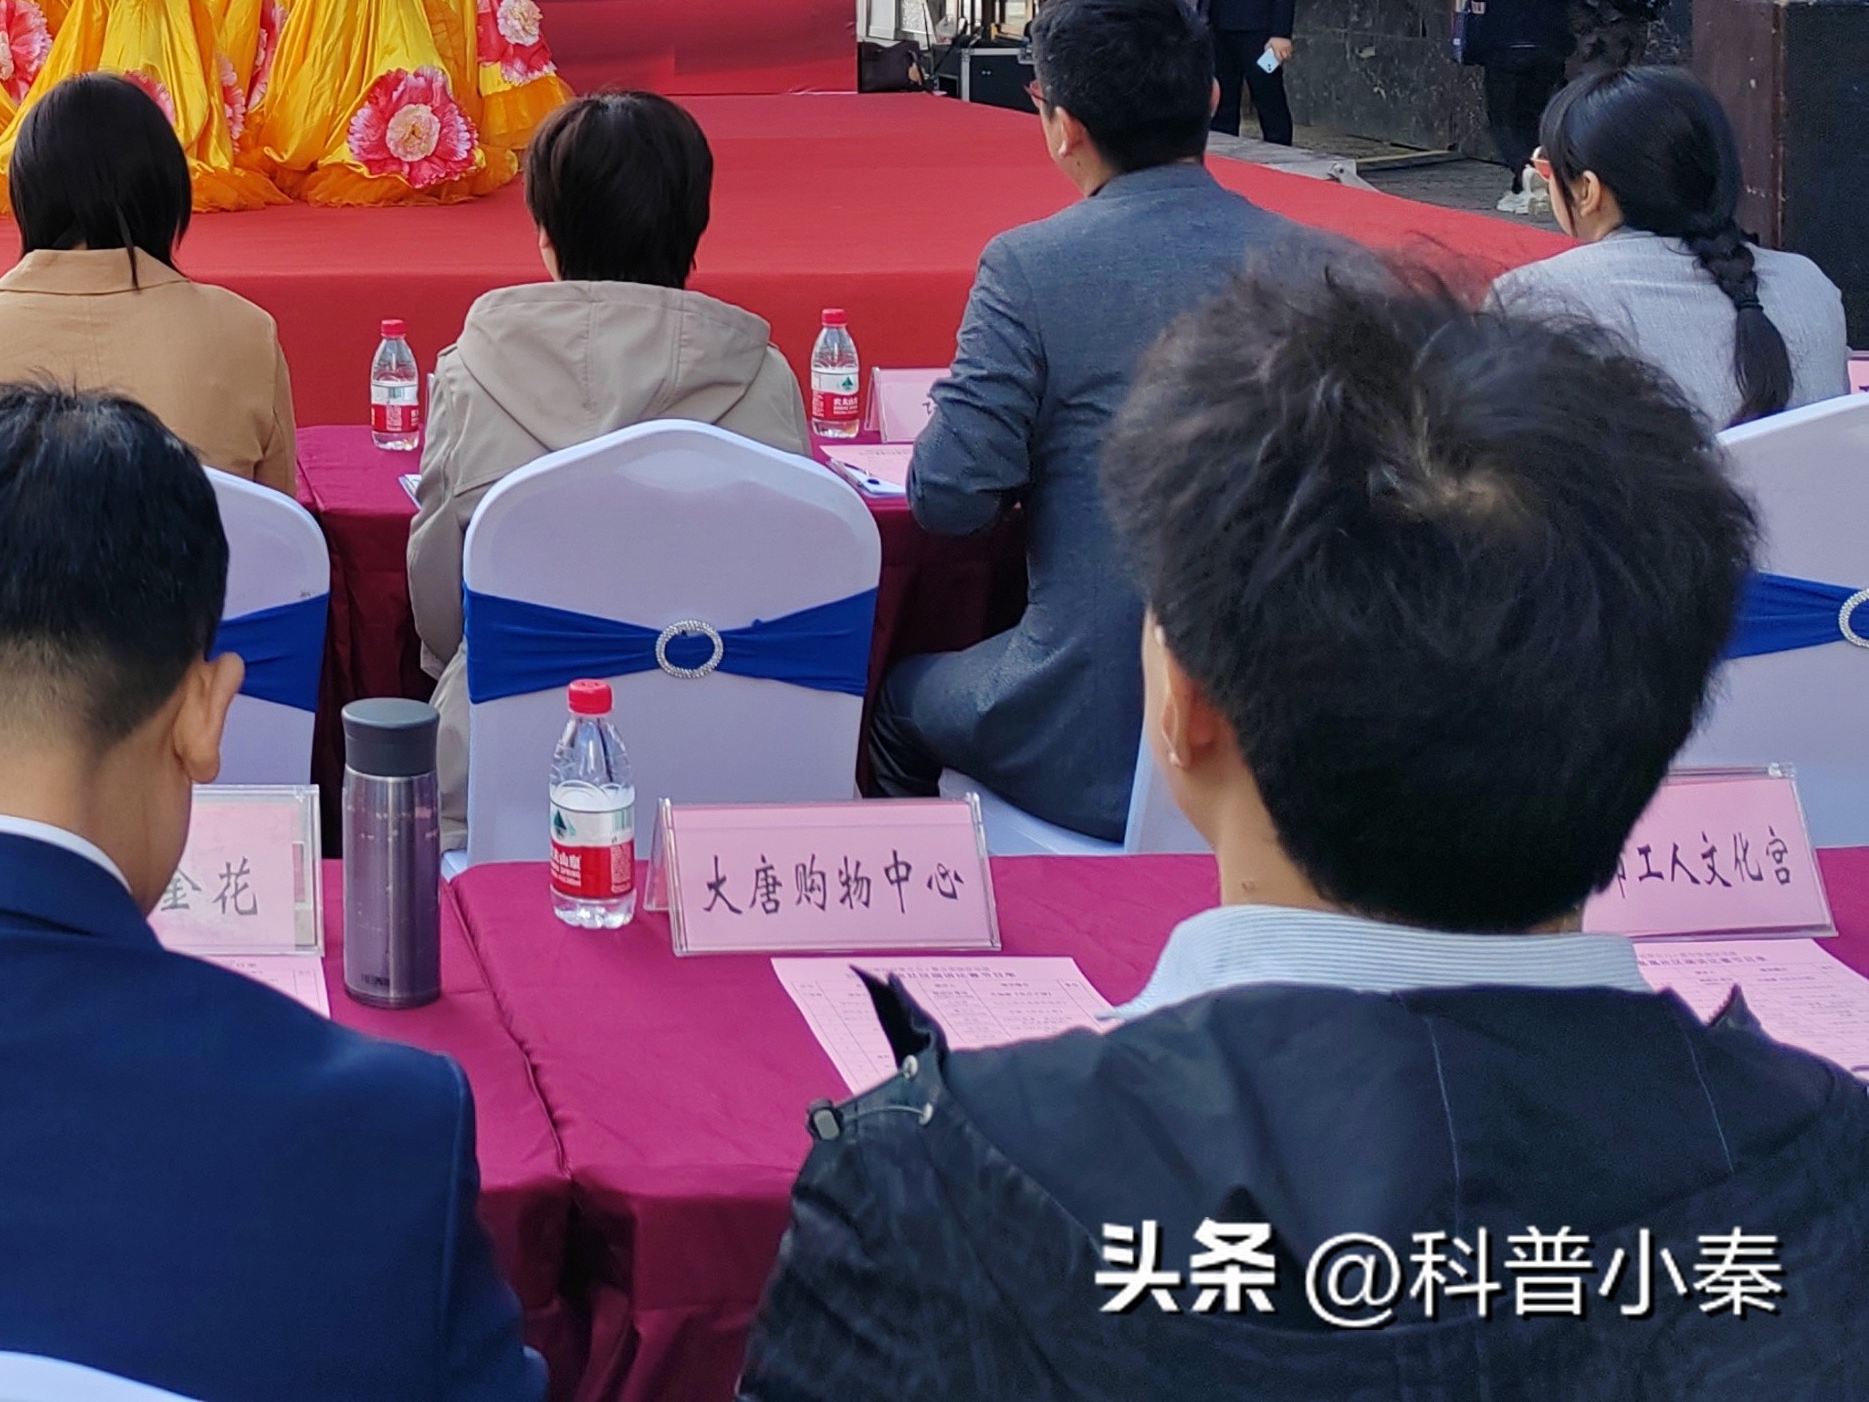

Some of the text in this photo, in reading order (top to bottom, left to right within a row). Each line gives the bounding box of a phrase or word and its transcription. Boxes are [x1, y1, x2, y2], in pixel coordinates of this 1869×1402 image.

[703, 849, 964, 915] 大唐购物中心
